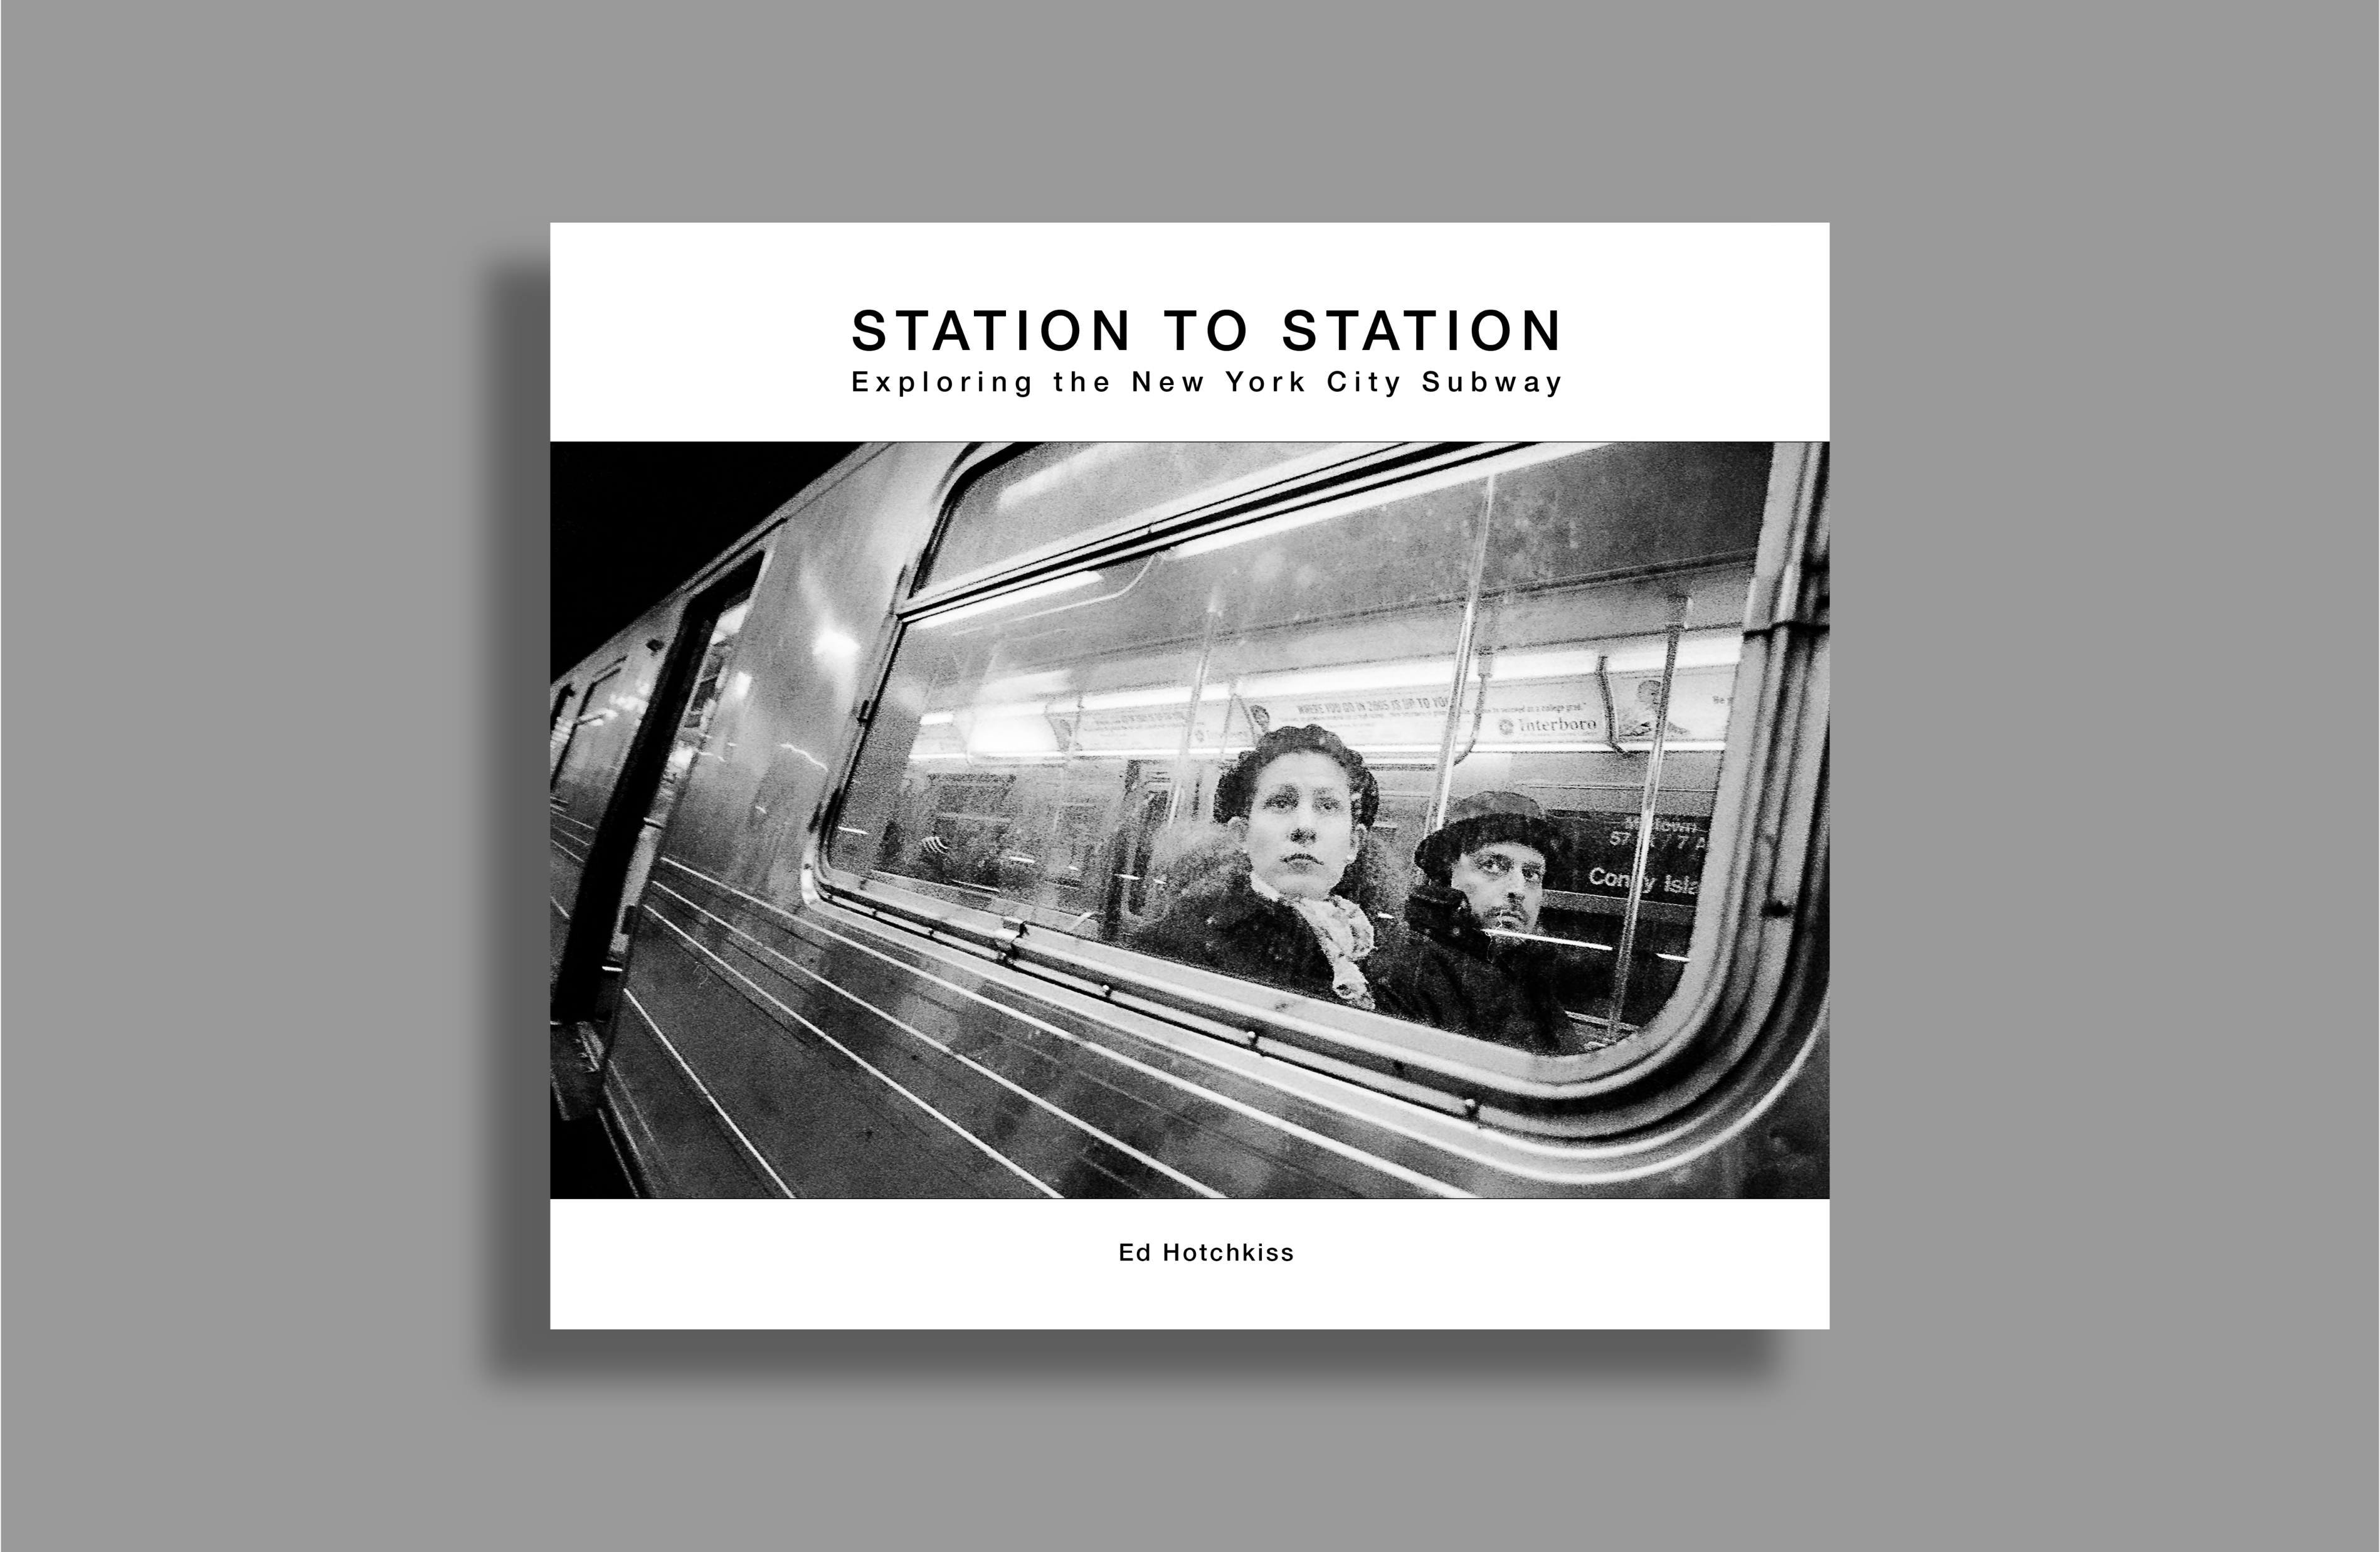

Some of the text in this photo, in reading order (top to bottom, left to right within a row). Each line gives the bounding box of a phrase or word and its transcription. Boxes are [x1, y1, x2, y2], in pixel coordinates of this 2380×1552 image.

[853, 310, 1557, 351] STATION TO STATION
[853, 371, 1560, 397] Exploring the New York City Subway
[1416, 697, 1431, 709] TO
[1518, 717, 1597, 732] Interboro
[1609, 830, 1631, 846] 57
[1589, 866, 1657, 894] Cony
[1120, 1243, 1293, 1261] Ed Hotchkiss
